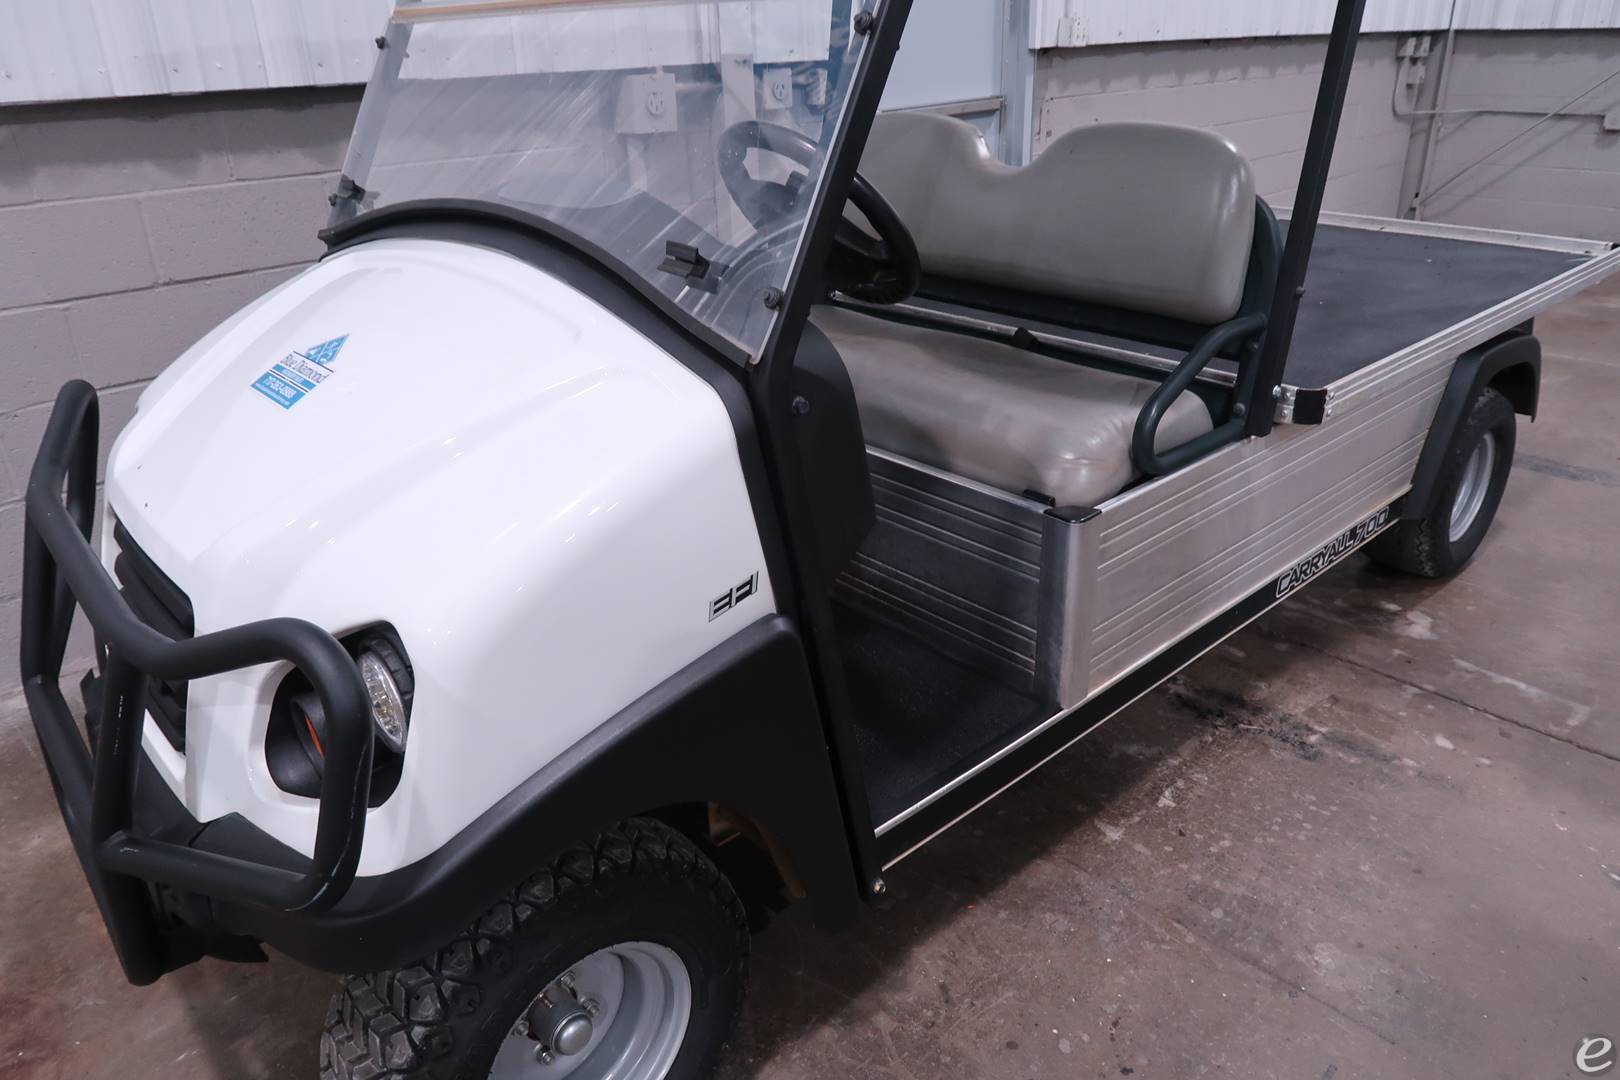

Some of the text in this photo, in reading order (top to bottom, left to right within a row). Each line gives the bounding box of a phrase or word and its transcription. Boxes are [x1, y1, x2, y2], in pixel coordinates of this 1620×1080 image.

[294, 358, 331, 385] Diamond
[1275, 505, 1390, 598] CARRYALL 700
[708, 570, 759, 623] EFI
